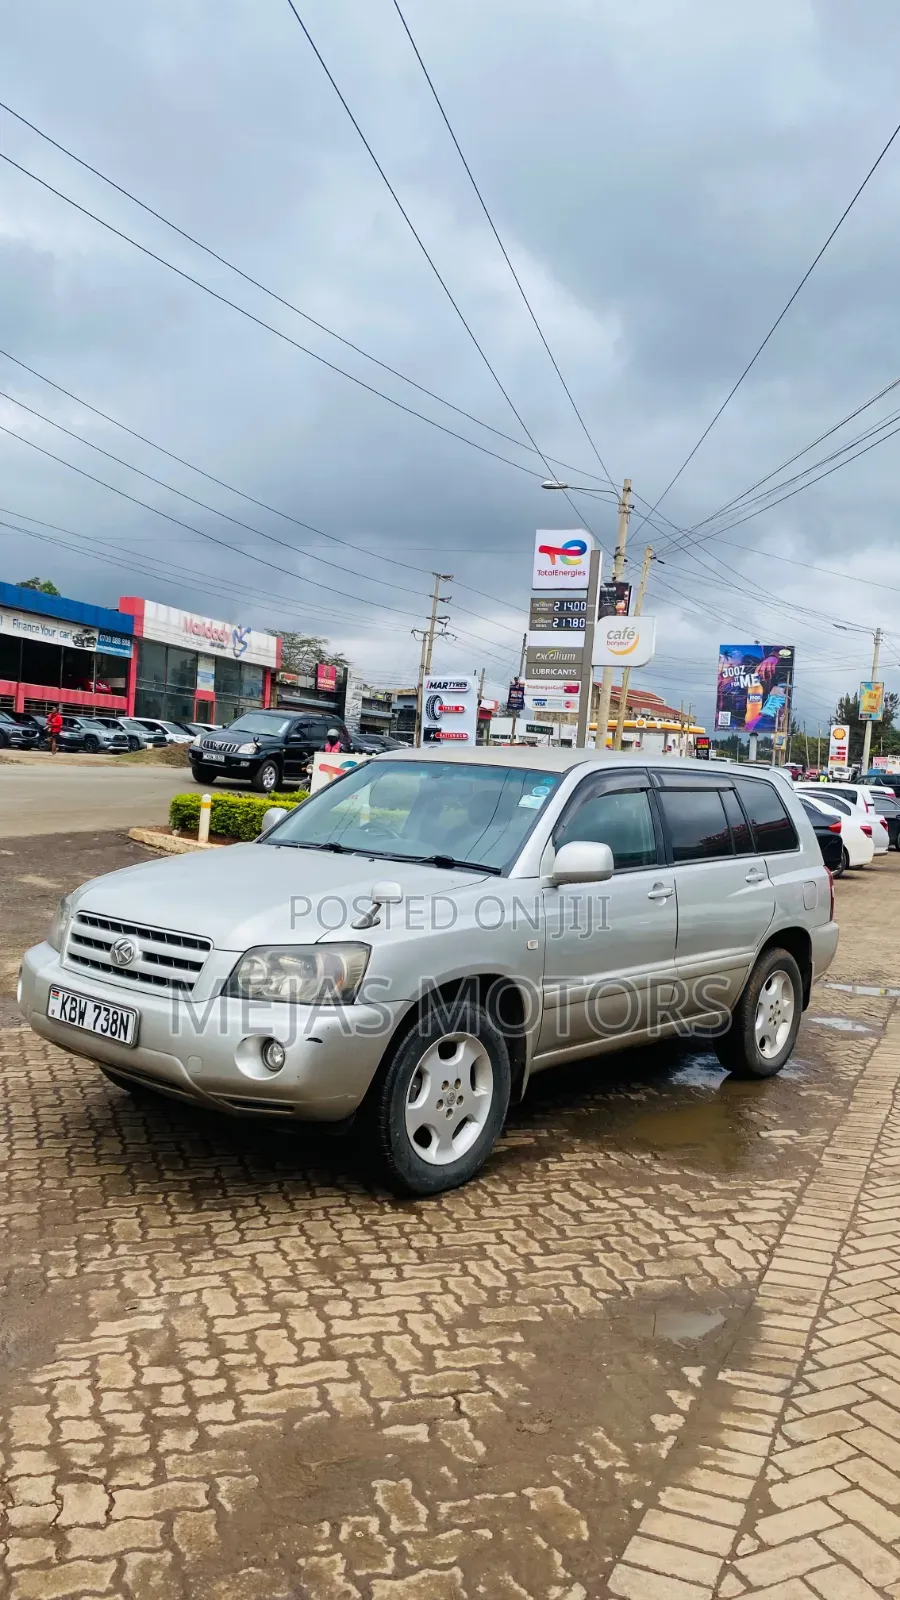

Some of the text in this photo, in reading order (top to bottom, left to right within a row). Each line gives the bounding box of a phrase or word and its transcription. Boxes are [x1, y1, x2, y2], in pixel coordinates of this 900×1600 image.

[537, 569, 586, 577] TotalEnergies
[12, 618, 39, 633] Finance
[40, 625, 56, 638] Your
[606, 627, 636, 640] café
[535, 650, 576, 661] excellium
[532, 668, 577, 676] LUBRICANTS
[722, 665, 746, 678] JOOZ
[739, 673, 760, 688] ME
[60, 993, 130, 1041] KBW 738N
